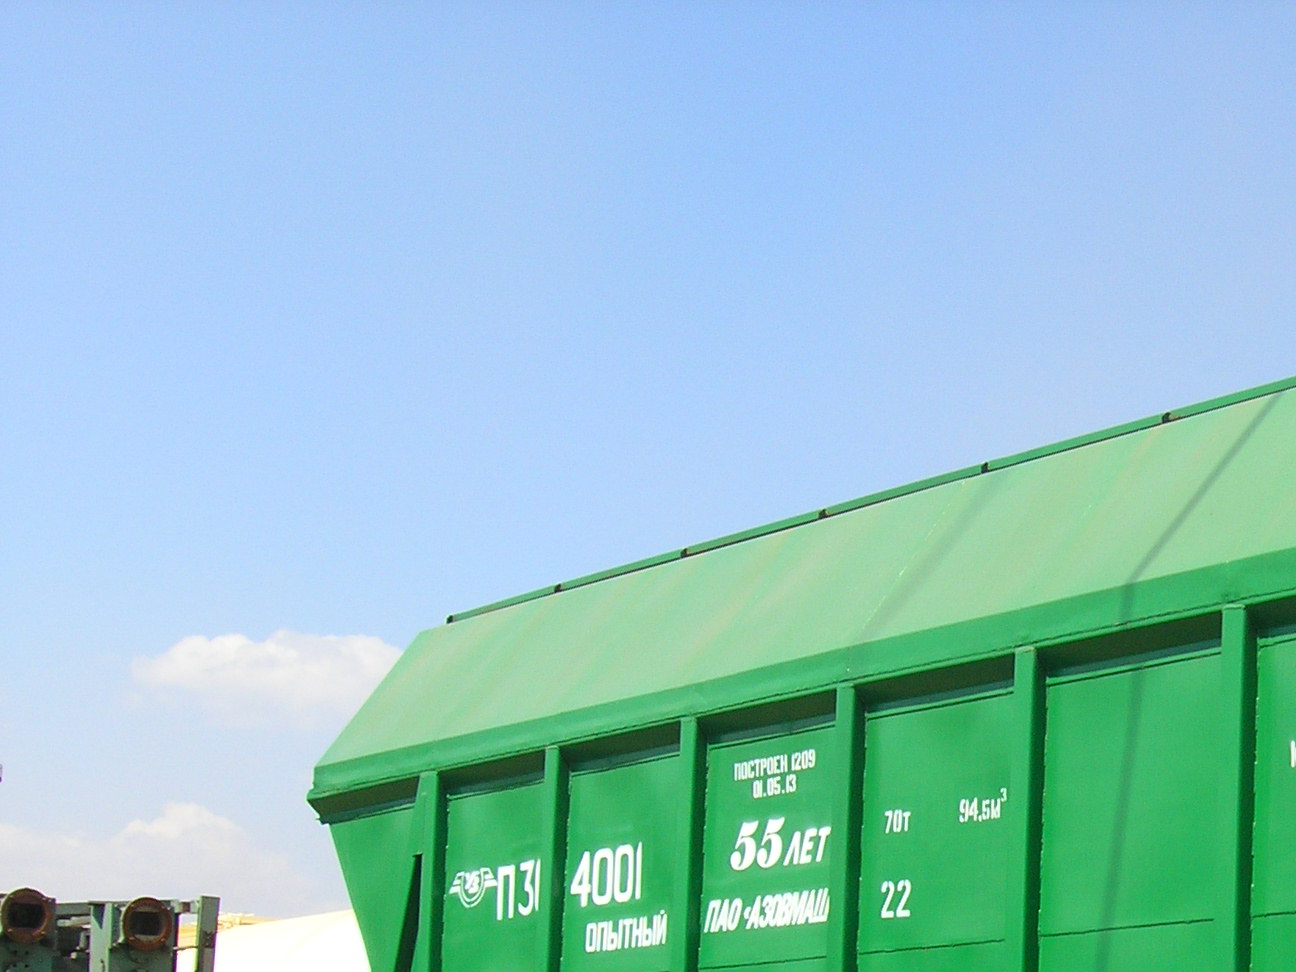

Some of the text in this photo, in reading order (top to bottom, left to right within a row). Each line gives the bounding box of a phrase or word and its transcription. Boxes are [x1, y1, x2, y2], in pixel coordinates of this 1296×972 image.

[733, 749, 816, 781] ПОСТРОЕН 1209
[752, 774, 797, 798] 01.05.13
[730, 816, 832, 871] 55 ЛЕТ
[570, 841, 643, 908] 4001
[703, 898, 743, 933] ПАО
[881, 879, 912, 919] 22
[585, 909, 668, 953] ОПЫТНЫЙ
